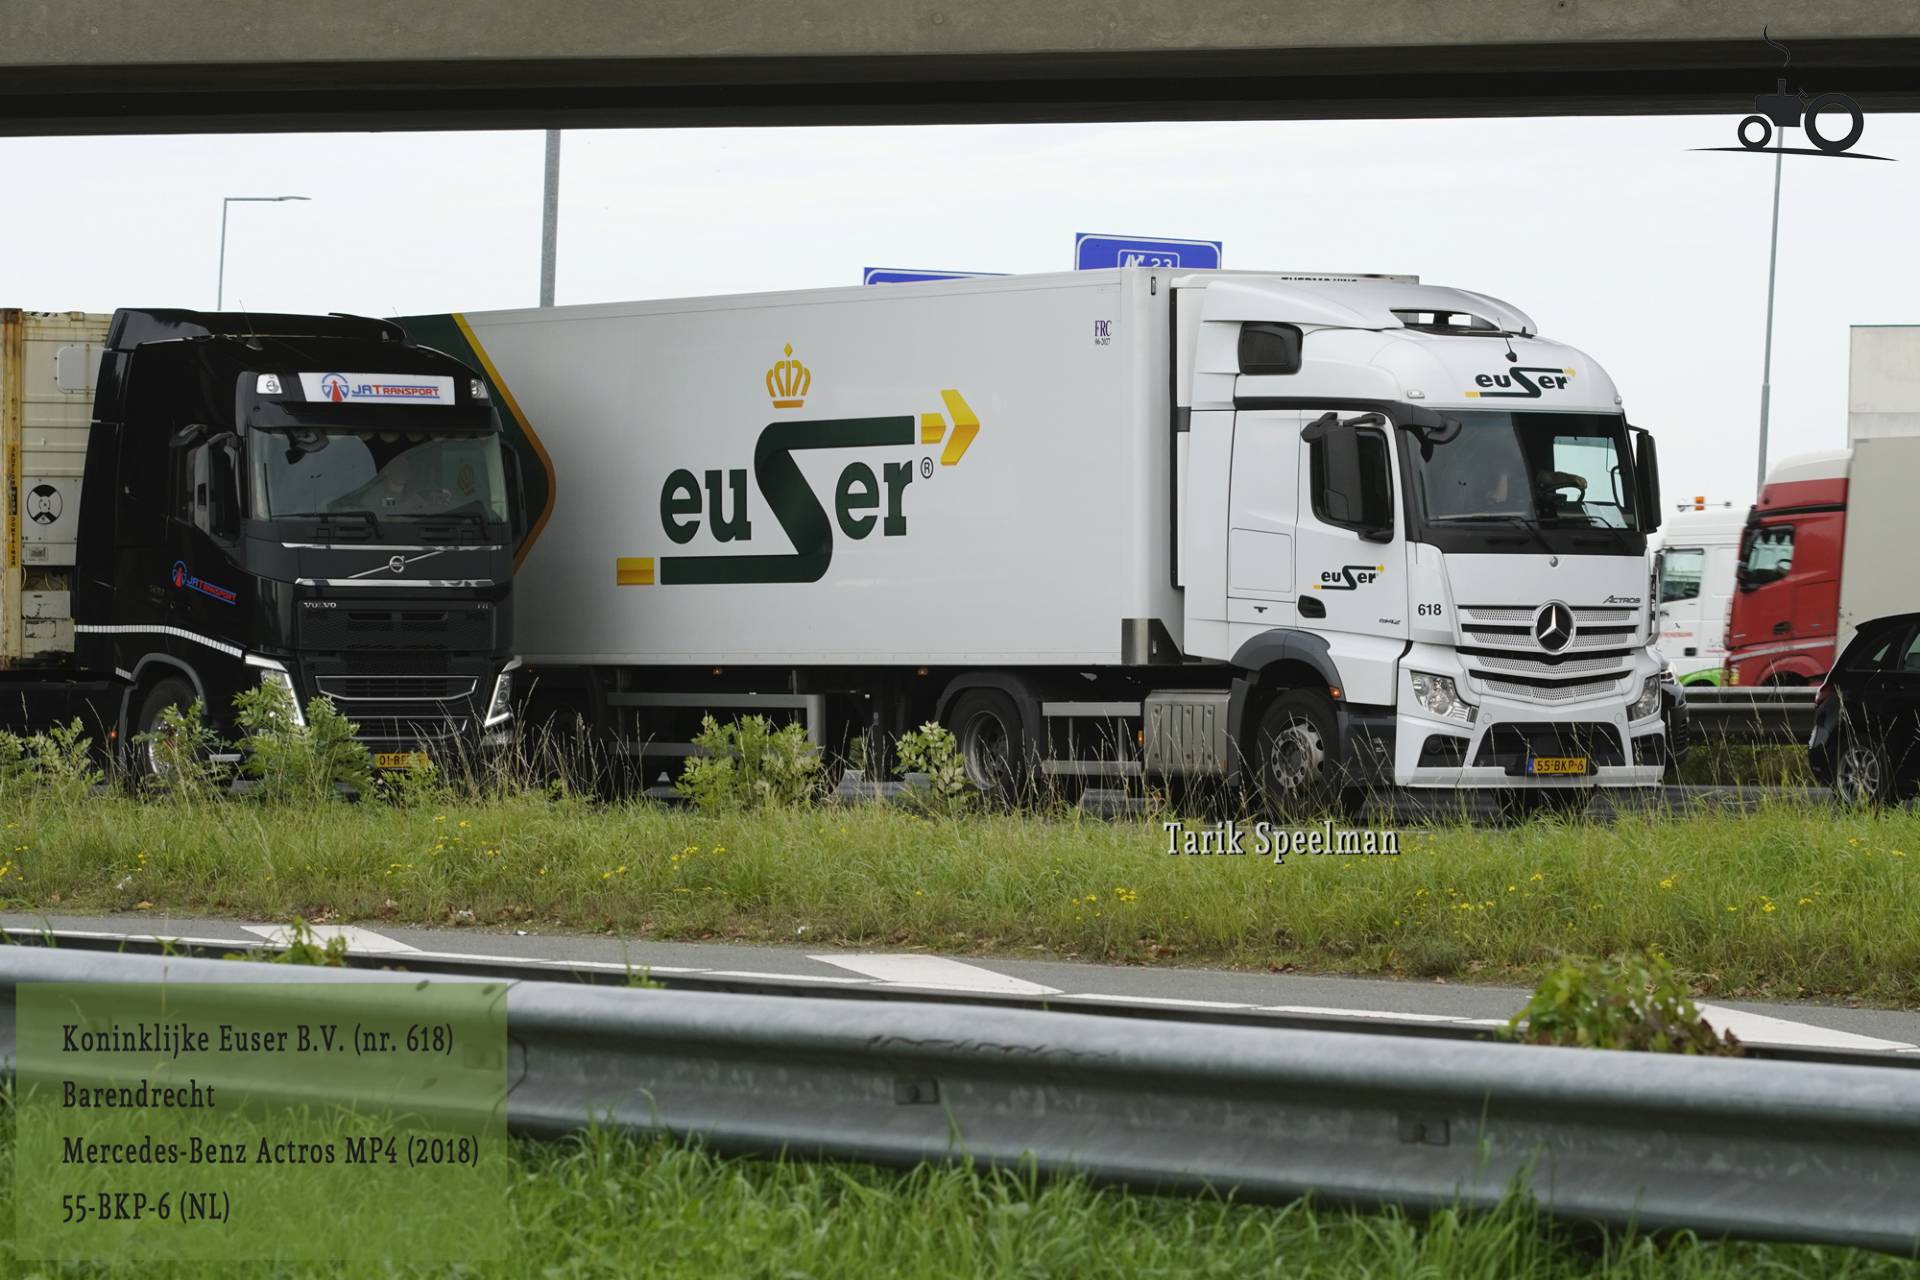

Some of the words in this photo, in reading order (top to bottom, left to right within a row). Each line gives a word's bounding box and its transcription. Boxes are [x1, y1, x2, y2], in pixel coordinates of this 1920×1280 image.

[1094, 319, 1112, 337] FRC
[1417, 603, 1442, 616] 618
[1537, 760, 1584, 772] 55-BKP-6
